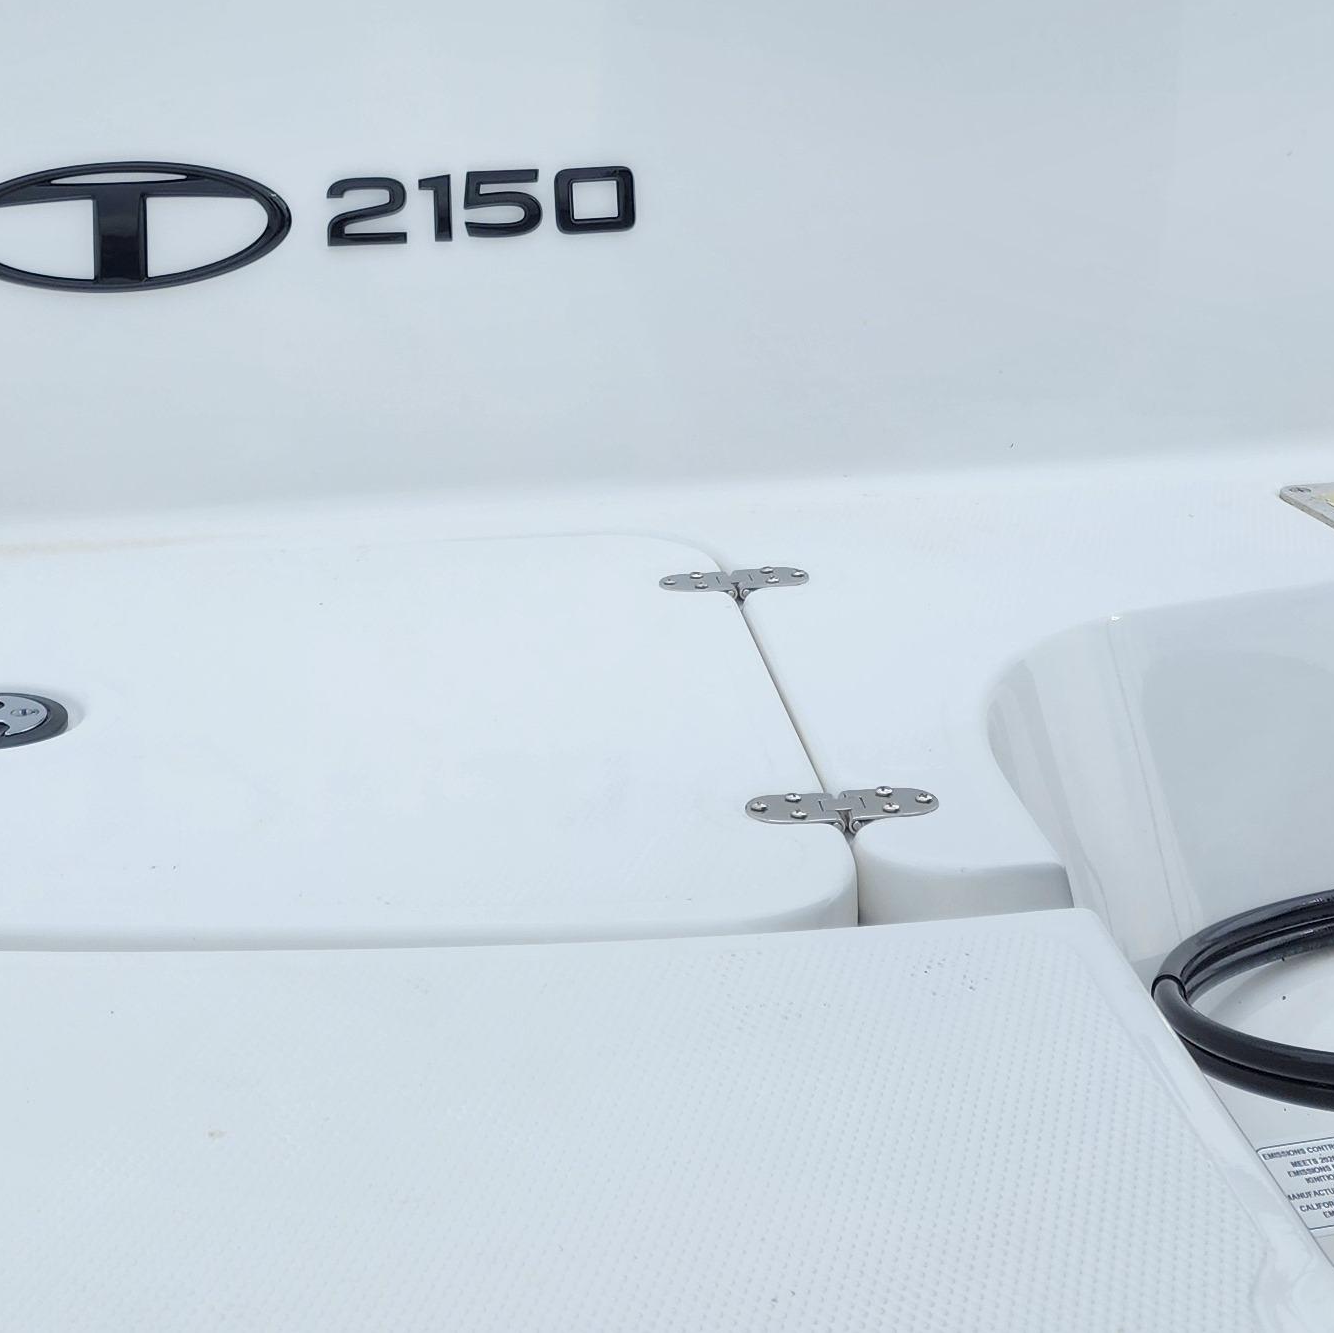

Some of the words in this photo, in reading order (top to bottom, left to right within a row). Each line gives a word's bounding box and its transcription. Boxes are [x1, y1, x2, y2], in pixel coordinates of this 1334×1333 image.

[326, 165, 636, 248] 2150
[1262, 1149, 1307, 1160] EMISSIONS
[1291, 1159, 1319, 1167] MEETS
[1287, 1166, 1332, 1177] EMISSIONS
